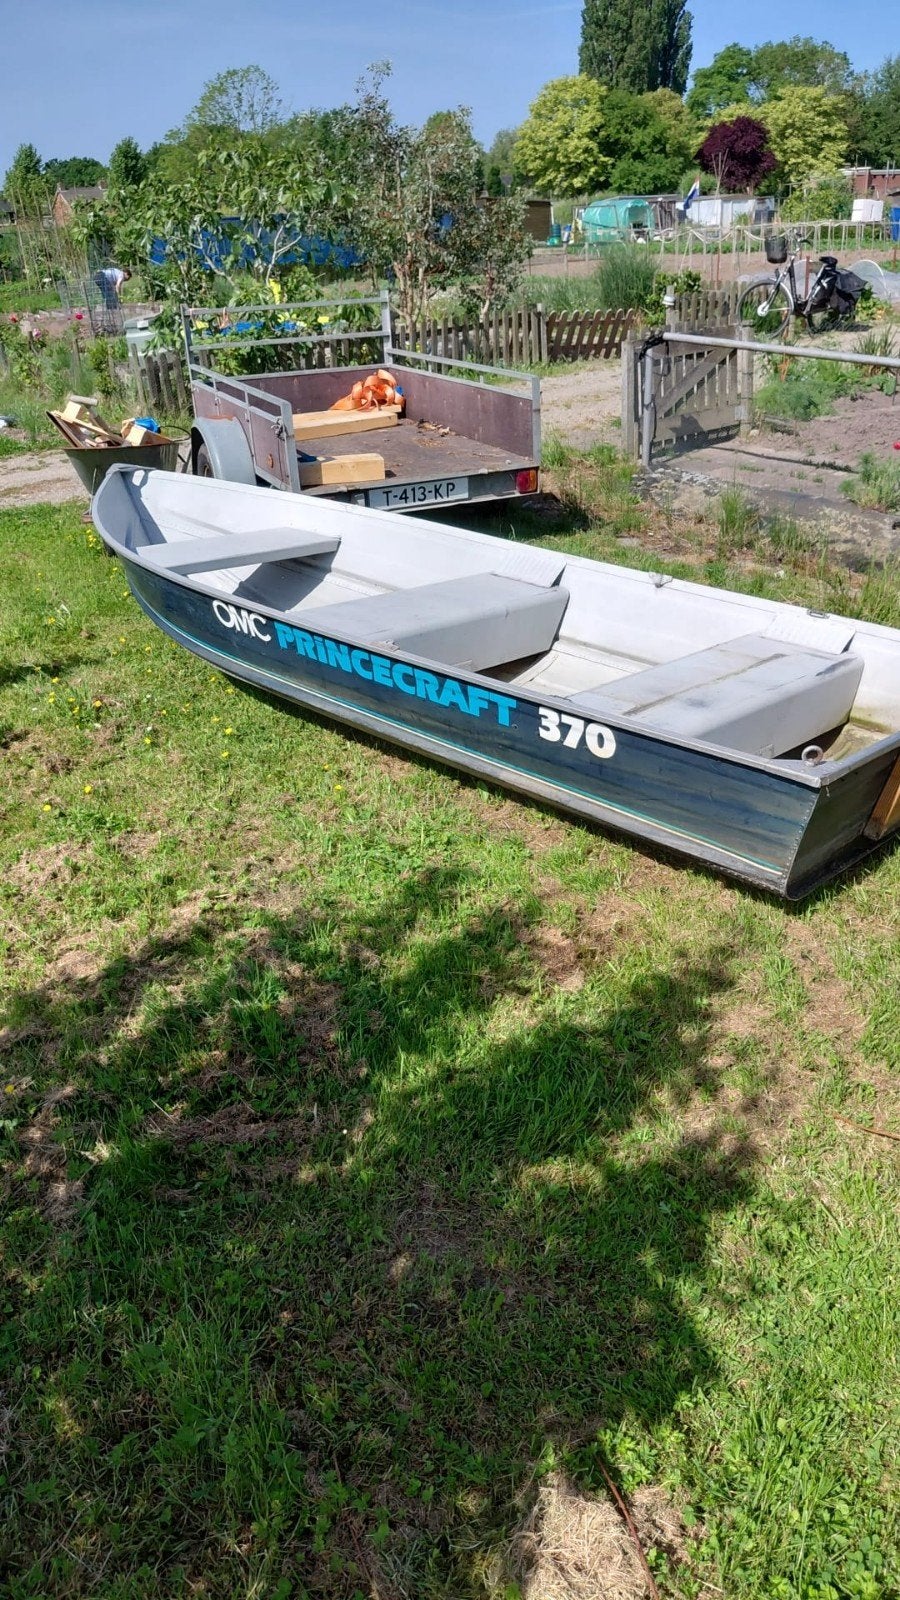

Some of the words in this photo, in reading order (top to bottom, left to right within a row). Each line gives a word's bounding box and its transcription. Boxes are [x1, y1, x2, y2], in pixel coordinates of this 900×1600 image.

[383, 482, 455, 506] T-413-KP
[212, 600, 271, 642] OMC
[538, 706, 616, 758] 370
